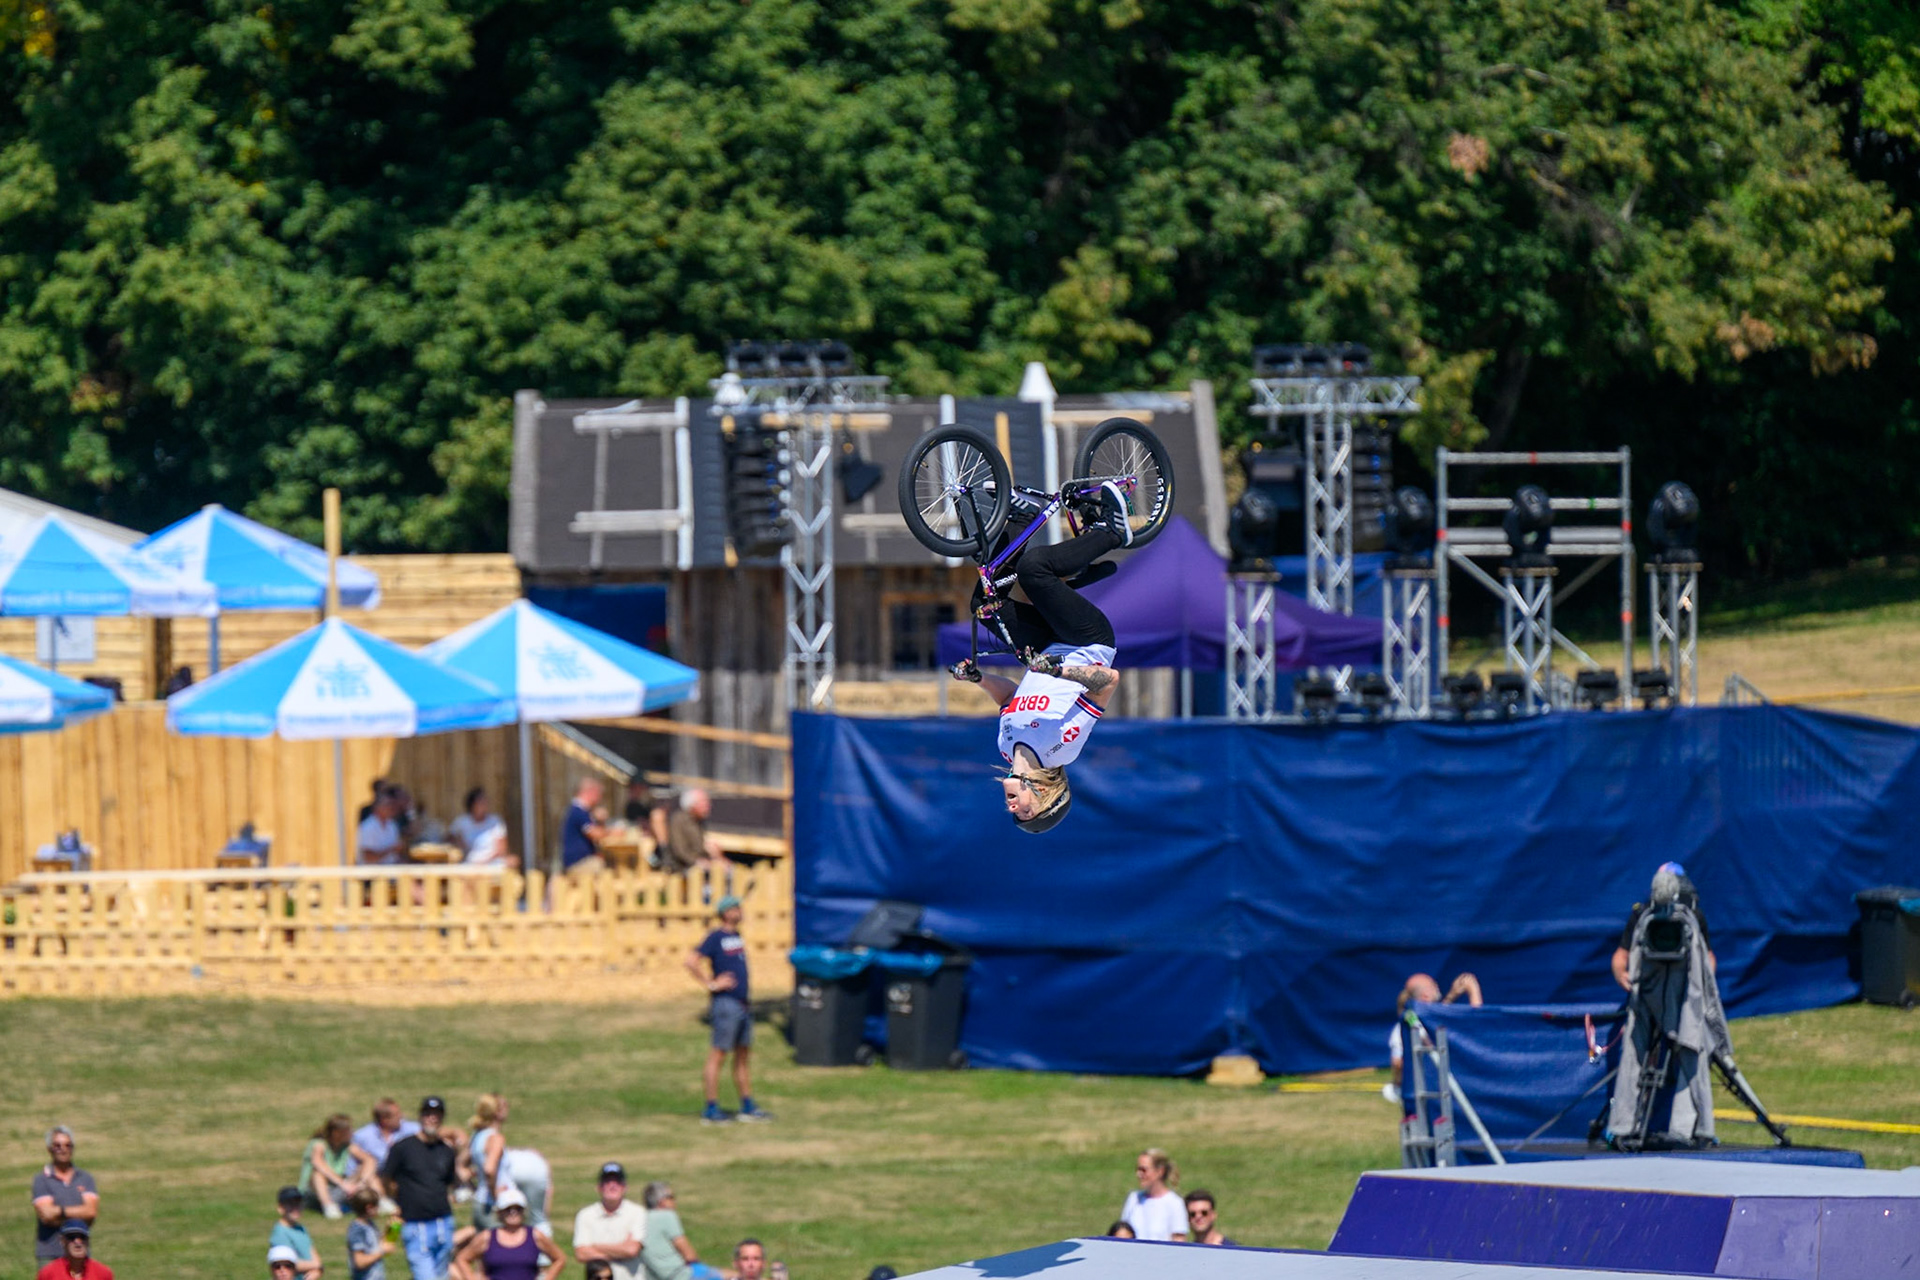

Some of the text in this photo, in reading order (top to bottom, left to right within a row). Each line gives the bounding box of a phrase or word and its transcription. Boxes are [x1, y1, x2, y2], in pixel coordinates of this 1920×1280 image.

[1148, 477, 1165, 522] GSPORT
[1018, 695, 1050, 711] GBR
[1050, 742, 1065, 754] HSBC
